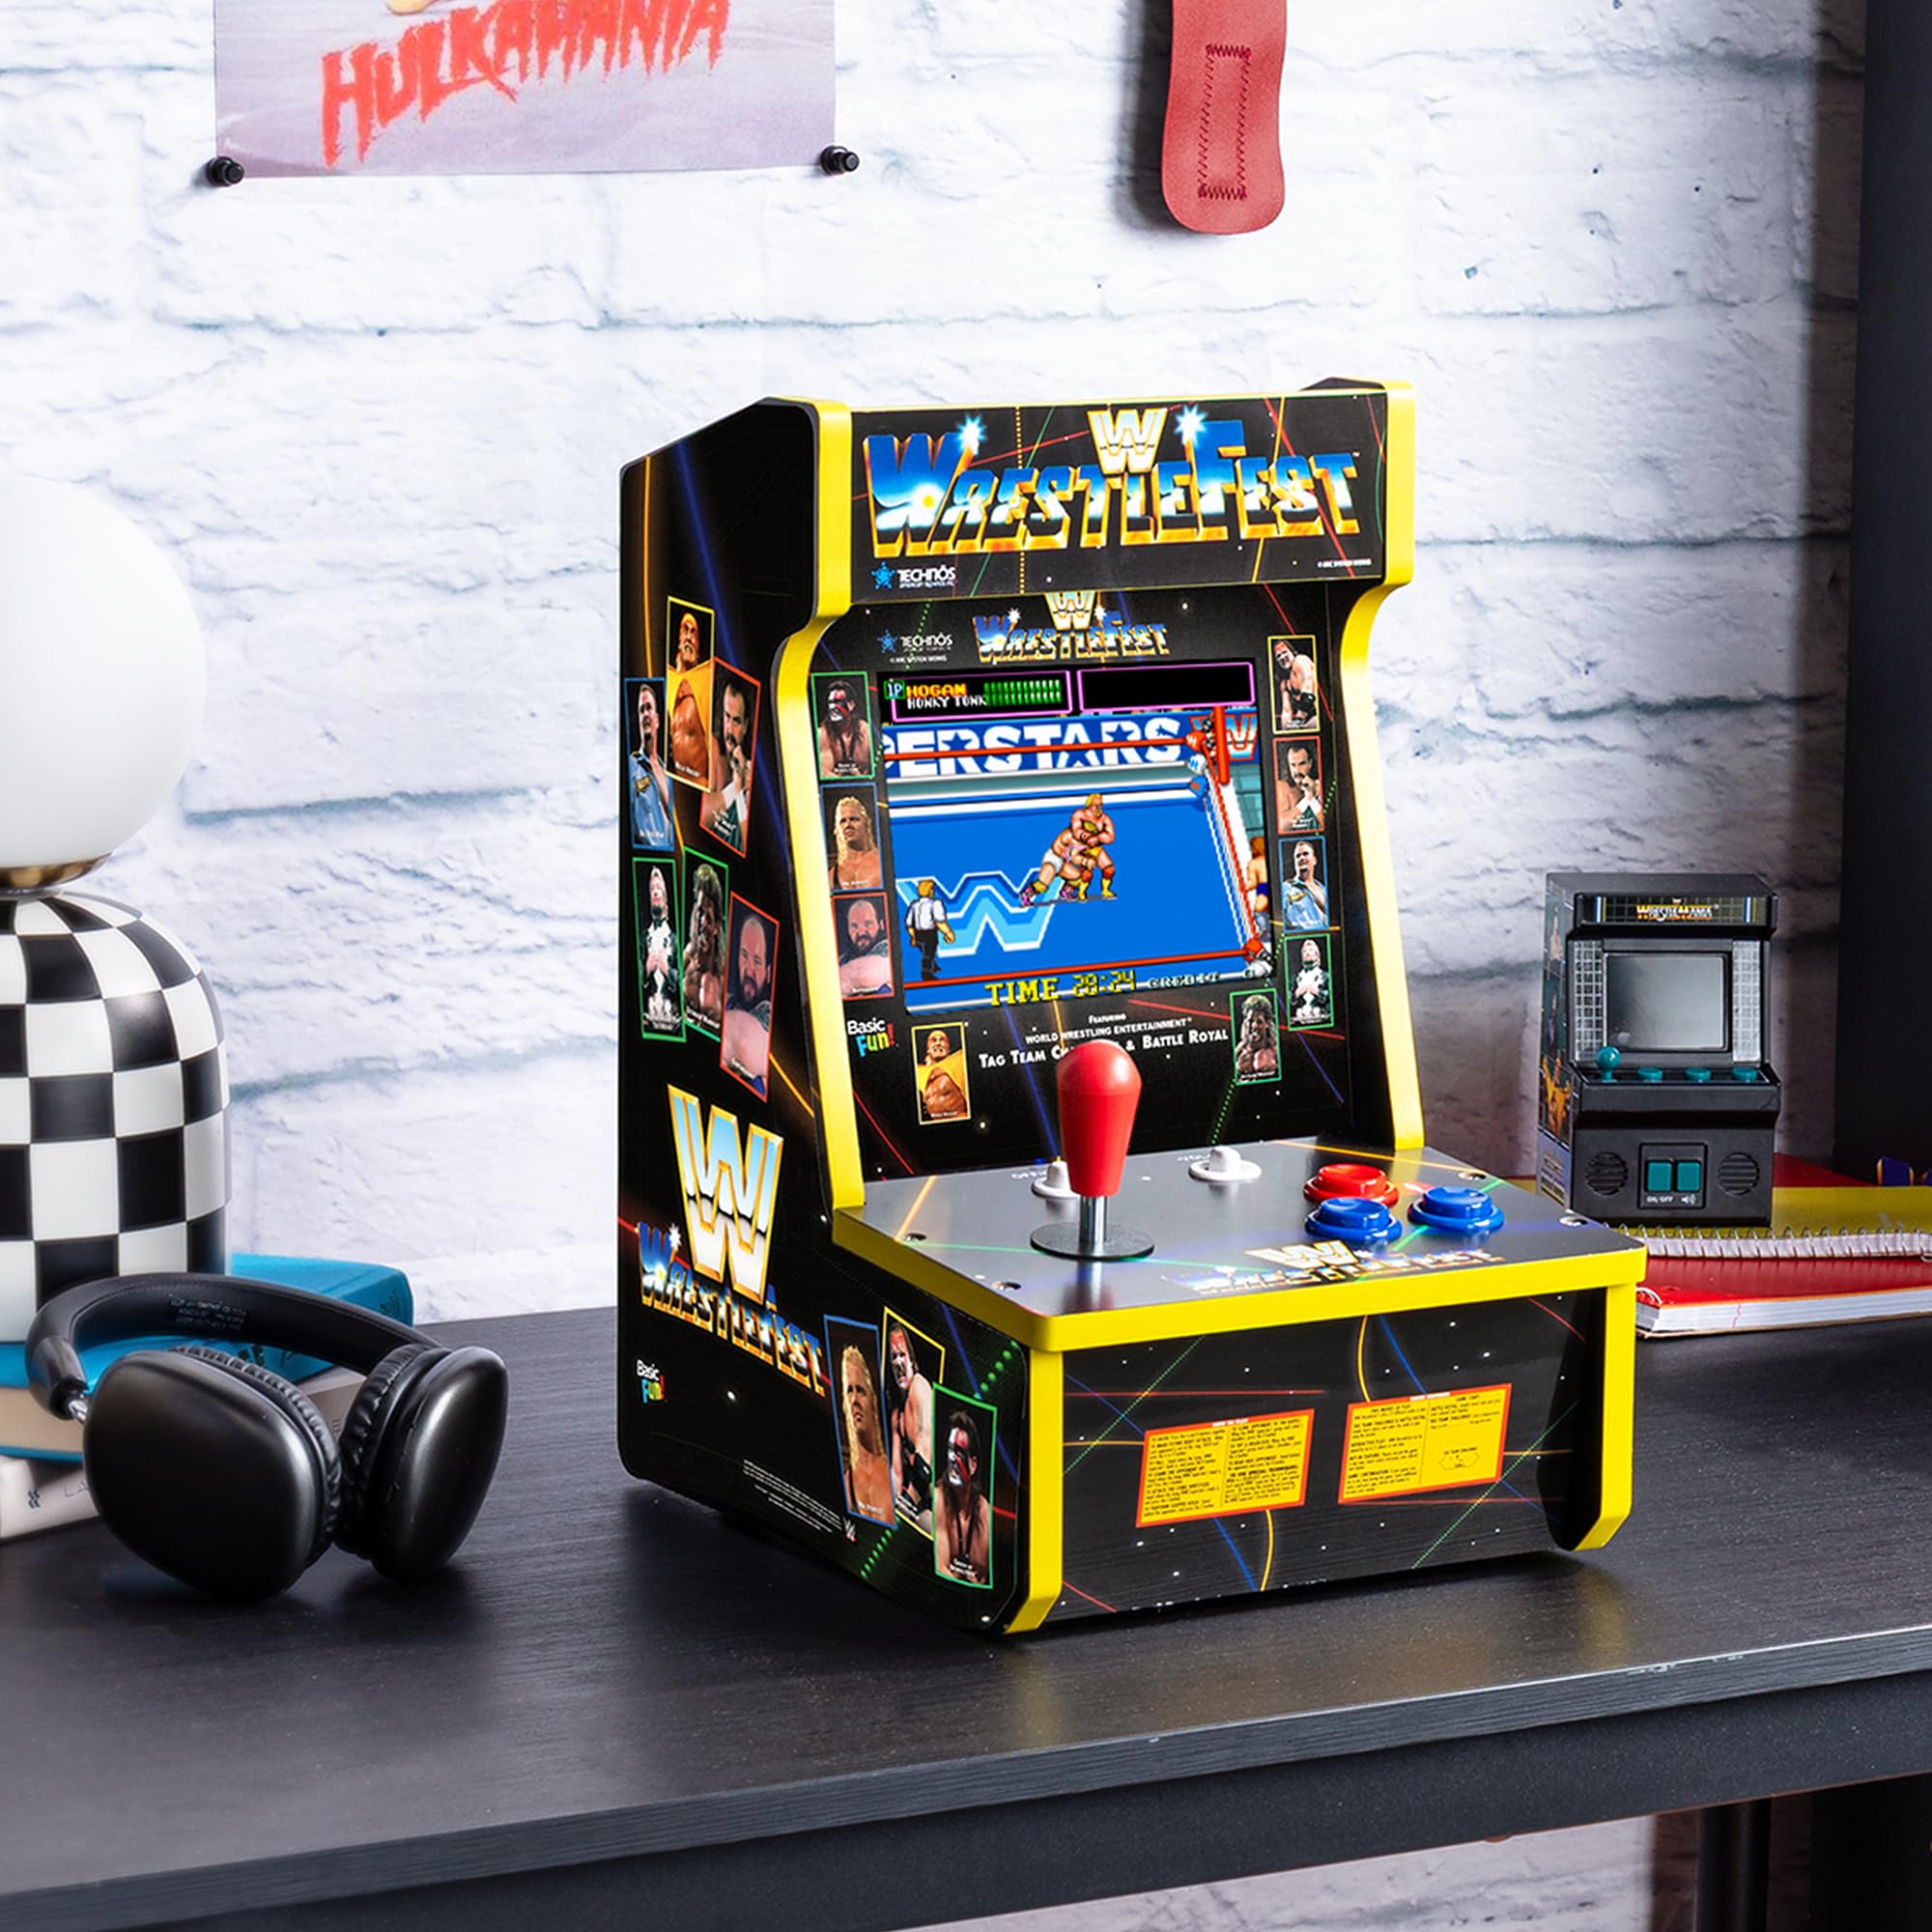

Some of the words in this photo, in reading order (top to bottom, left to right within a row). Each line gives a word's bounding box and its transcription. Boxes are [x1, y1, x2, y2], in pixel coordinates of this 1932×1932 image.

[322, 0, 729, 168] HULKAMANIA
[906, 682, 967, 697] HOGAN
[907, 696, 950, 710] HONKY
[984, 978, 1059, 1006] TIME
[1073, 970, 1135, 997] 28:24
[847, 1017, 886, 1035] Basic
[1025, 1032, 1059, 1045] WORLD
[856, 1023, 895, 1057] Fun!
[979, 1053, 1006, 1068] TAG
[1010, 1049, 1046, 1065] TEAM
[1125, 1039, 1136, 1052] &
[1142, 1035, 1184, 1050] BATTLE
[1188, 1029, 1229, 1046] ROYAL
